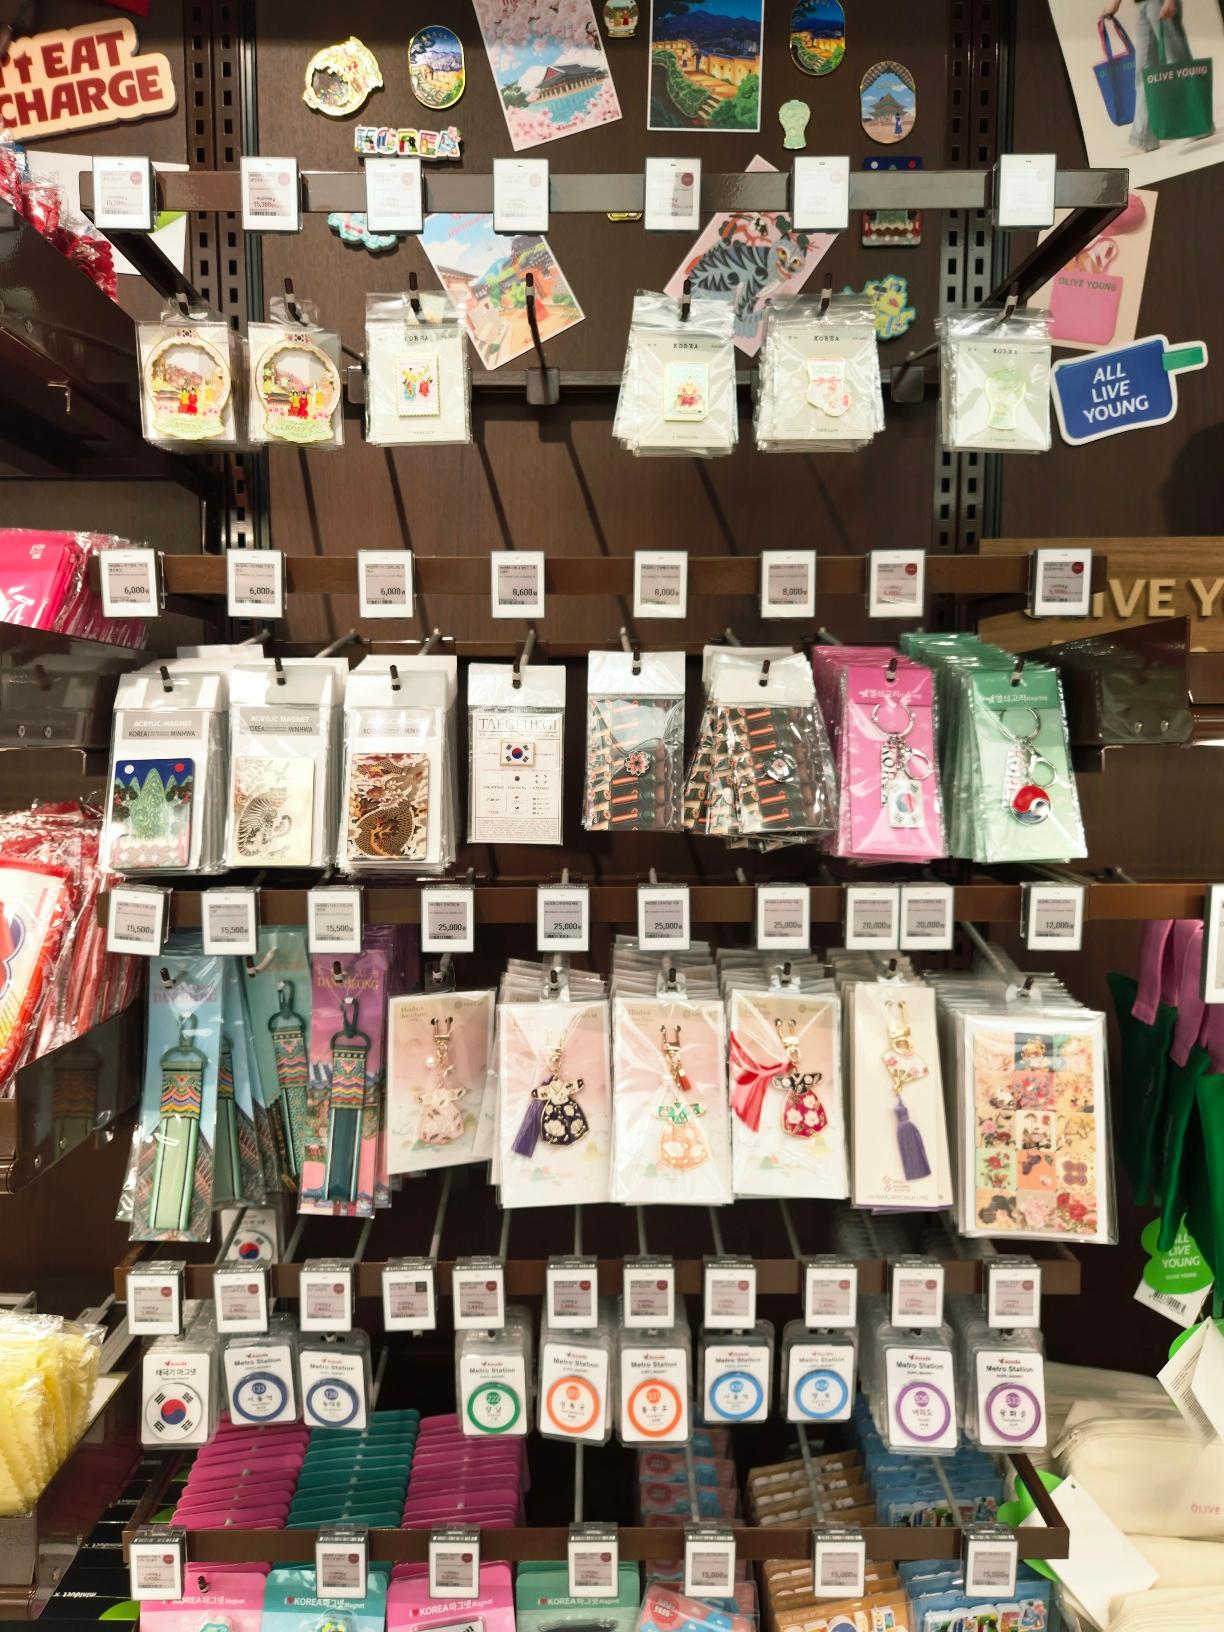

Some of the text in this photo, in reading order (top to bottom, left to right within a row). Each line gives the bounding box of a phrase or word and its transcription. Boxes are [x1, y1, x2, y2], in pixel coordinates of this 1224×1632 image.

[40, 30, 125, 78] EAT
[1146, 65, 1208, 85] OLIVE YOUNG
[1058, 276, 1117, 292] OLIVE YOUNG
[1092, 362, 1126, 384] ALL
[1091, 380, 1131, 403] LIVE
[1082, 396, 1150, 424] YOUNG
[128, 730, 148, 738] KOREA
[1168, 1244, 1190, 1256] LIVE
[1162, 1256, 1200, 1269] YOUNG
[176, 1367, 197, 1376] 마그넷
[896, 1361, 944, 1370] Metro Station
[1190, 1503, 1221, 1515] OLIVE
[202, 1596, 224, 1605] 마그넷
[294, 1597, 322, 1606] KOREA
[548, 1597, 576, 1605] KOREA
[419, 1605, 449, 1617] KOREA
[448, 1599, 472, 1612] 마그넷
